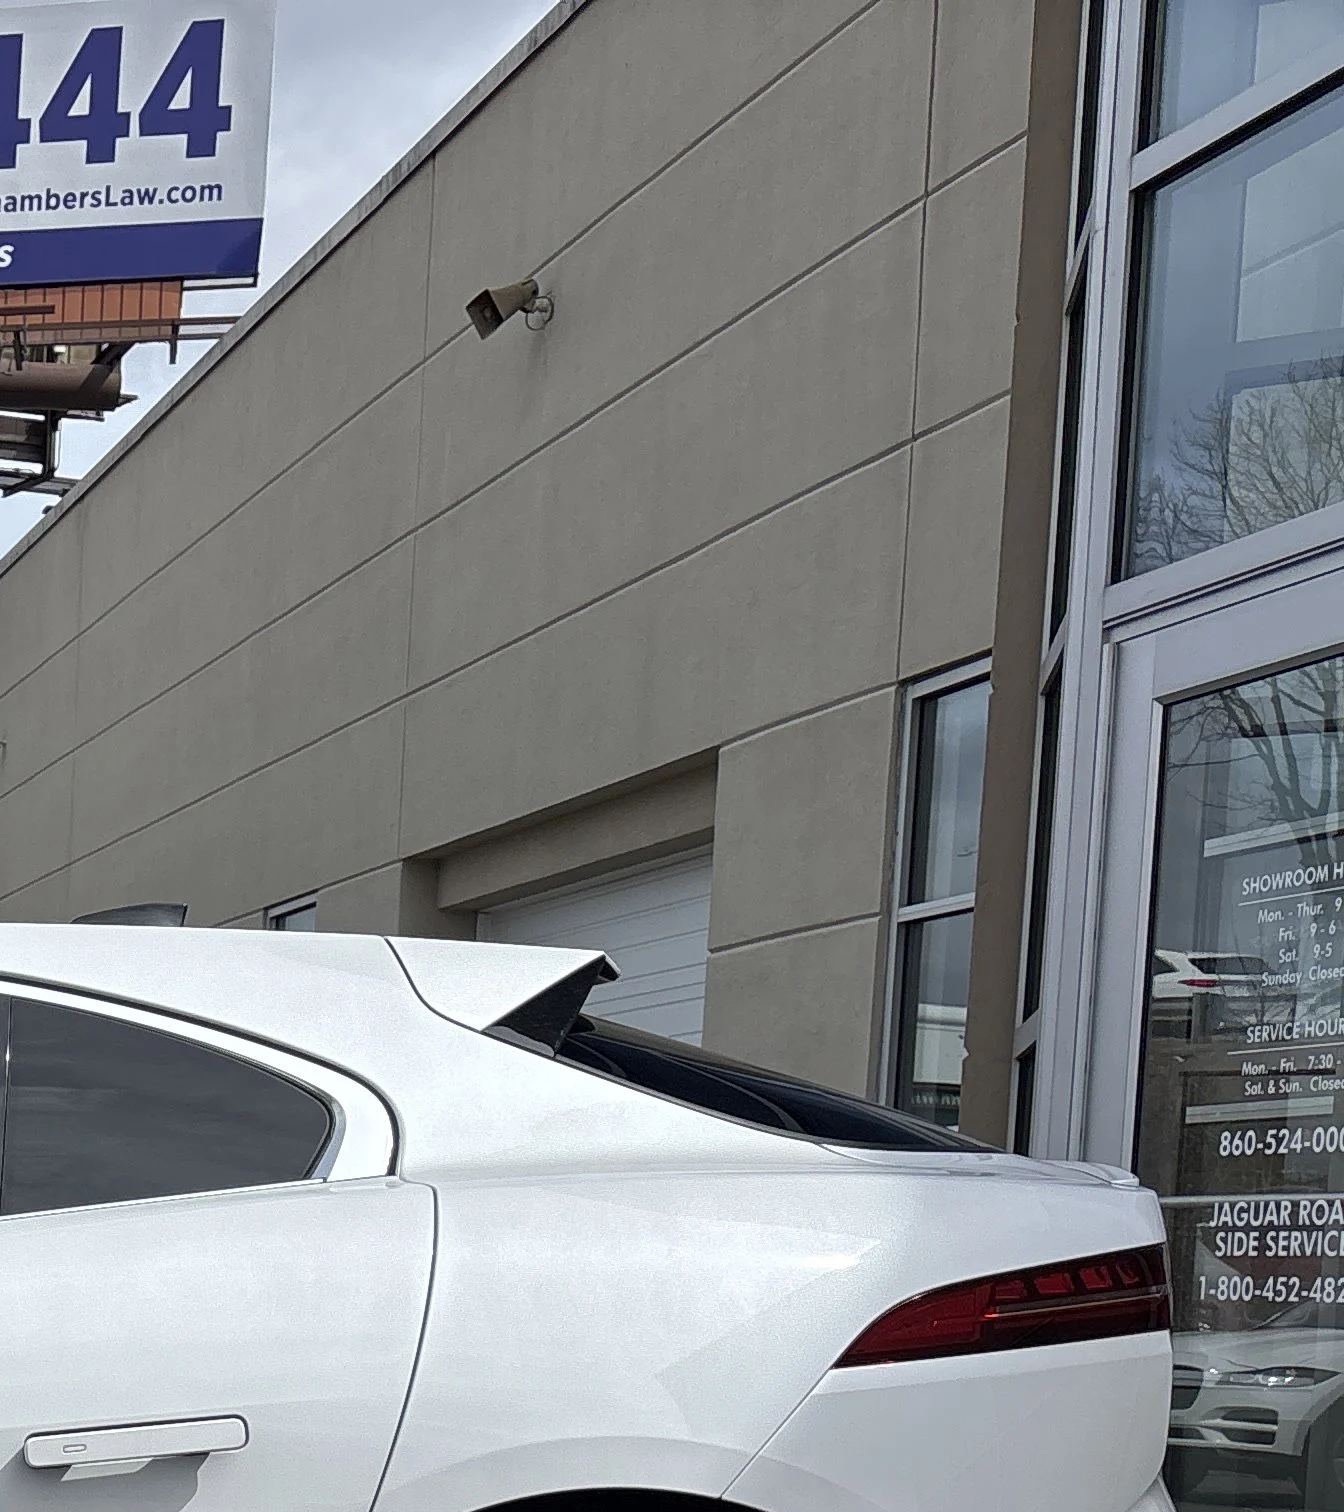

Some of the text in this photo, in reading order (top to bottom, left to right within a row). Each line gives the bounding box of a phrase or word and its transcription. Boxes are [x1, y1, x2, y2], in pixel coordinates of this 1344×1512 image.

[1241, 863, 1329, 896] SHOWROOM
[1257, 909, 1285, 924] Mon.
[1296, 902, 1324, 918] Thur.
[1278, 925, 1296, 942] Fri.
[1278, 948, 1299, 964] Sat.
[1261, 968, 1303, 987] Sunday
[1246, 1021, 1301, 1044] SERVICE
[1241, 1061, 1269, 1076] Mon.
[1279, 1057, 1297, 1073] Fri.
[1307, 1054, 1333, 1070] 7:30
[1244, 1081, 1264, 1096] Sat.
[1268, 1080, 1276, 1094] &
[1278, 1078, 1302, 1094] Sun.
[1209, 1200, 1292, 1228] JAGUAR
[1214, 1231, 1260, 1257] SIDE
